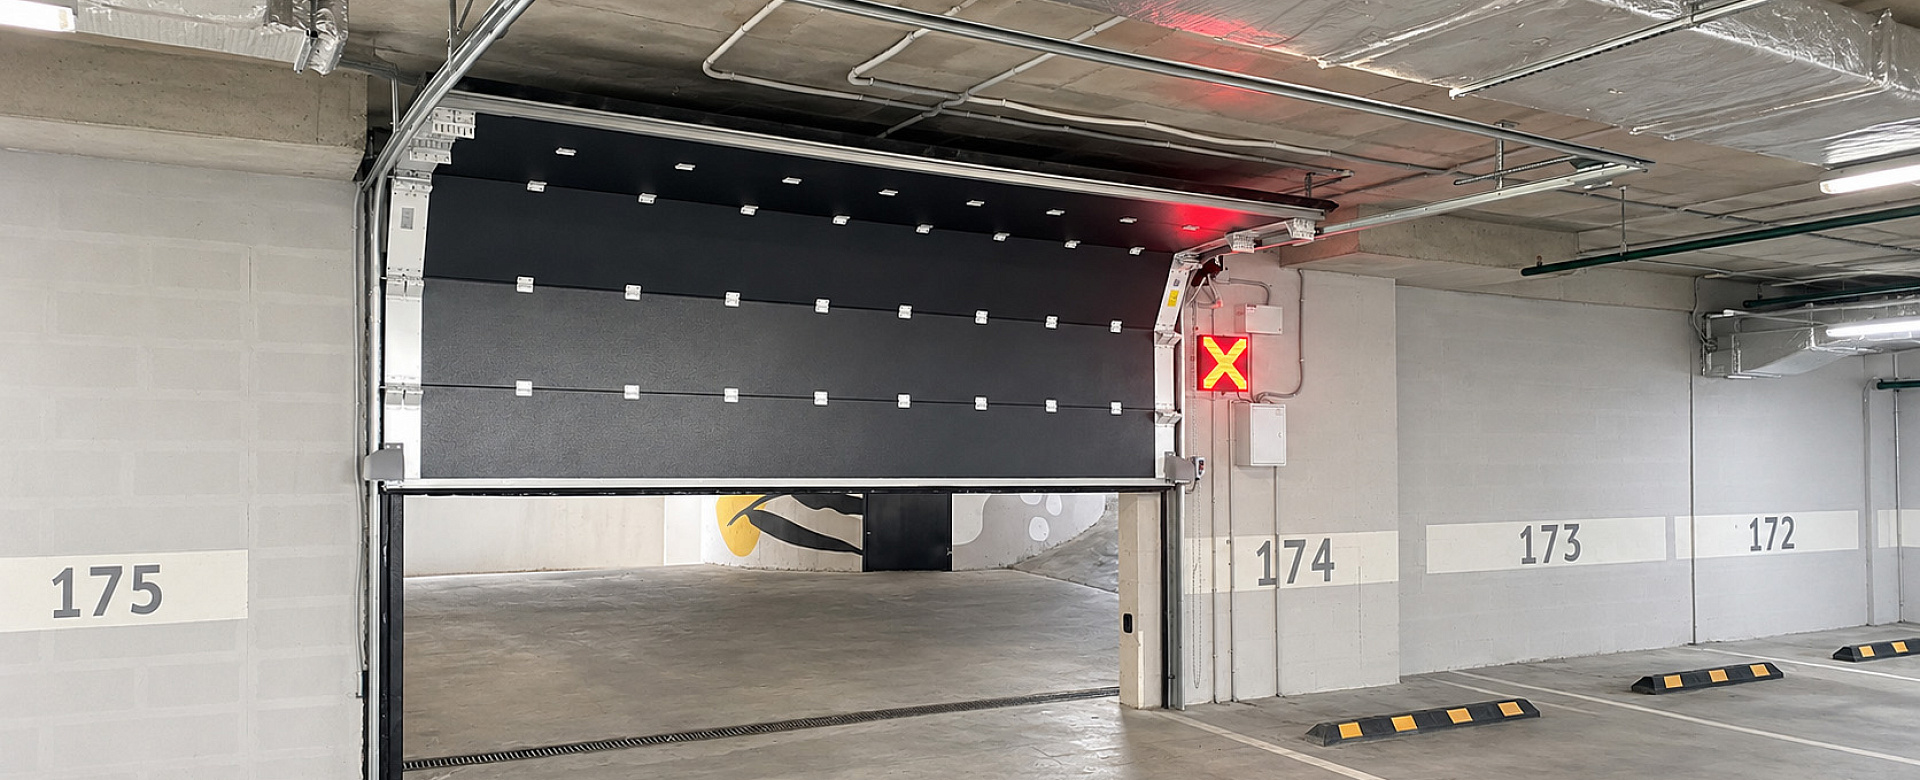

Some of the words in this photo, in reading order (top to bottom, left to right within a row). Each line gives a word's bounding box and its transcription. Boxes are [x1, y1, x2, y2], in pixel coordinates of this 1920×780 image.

[1519, 523, 1581, 565] 173
[1749, 516, 1795, 552] 172
[1256, 537, 1335, 587] 174
[52, 564, 163, 619] 175
